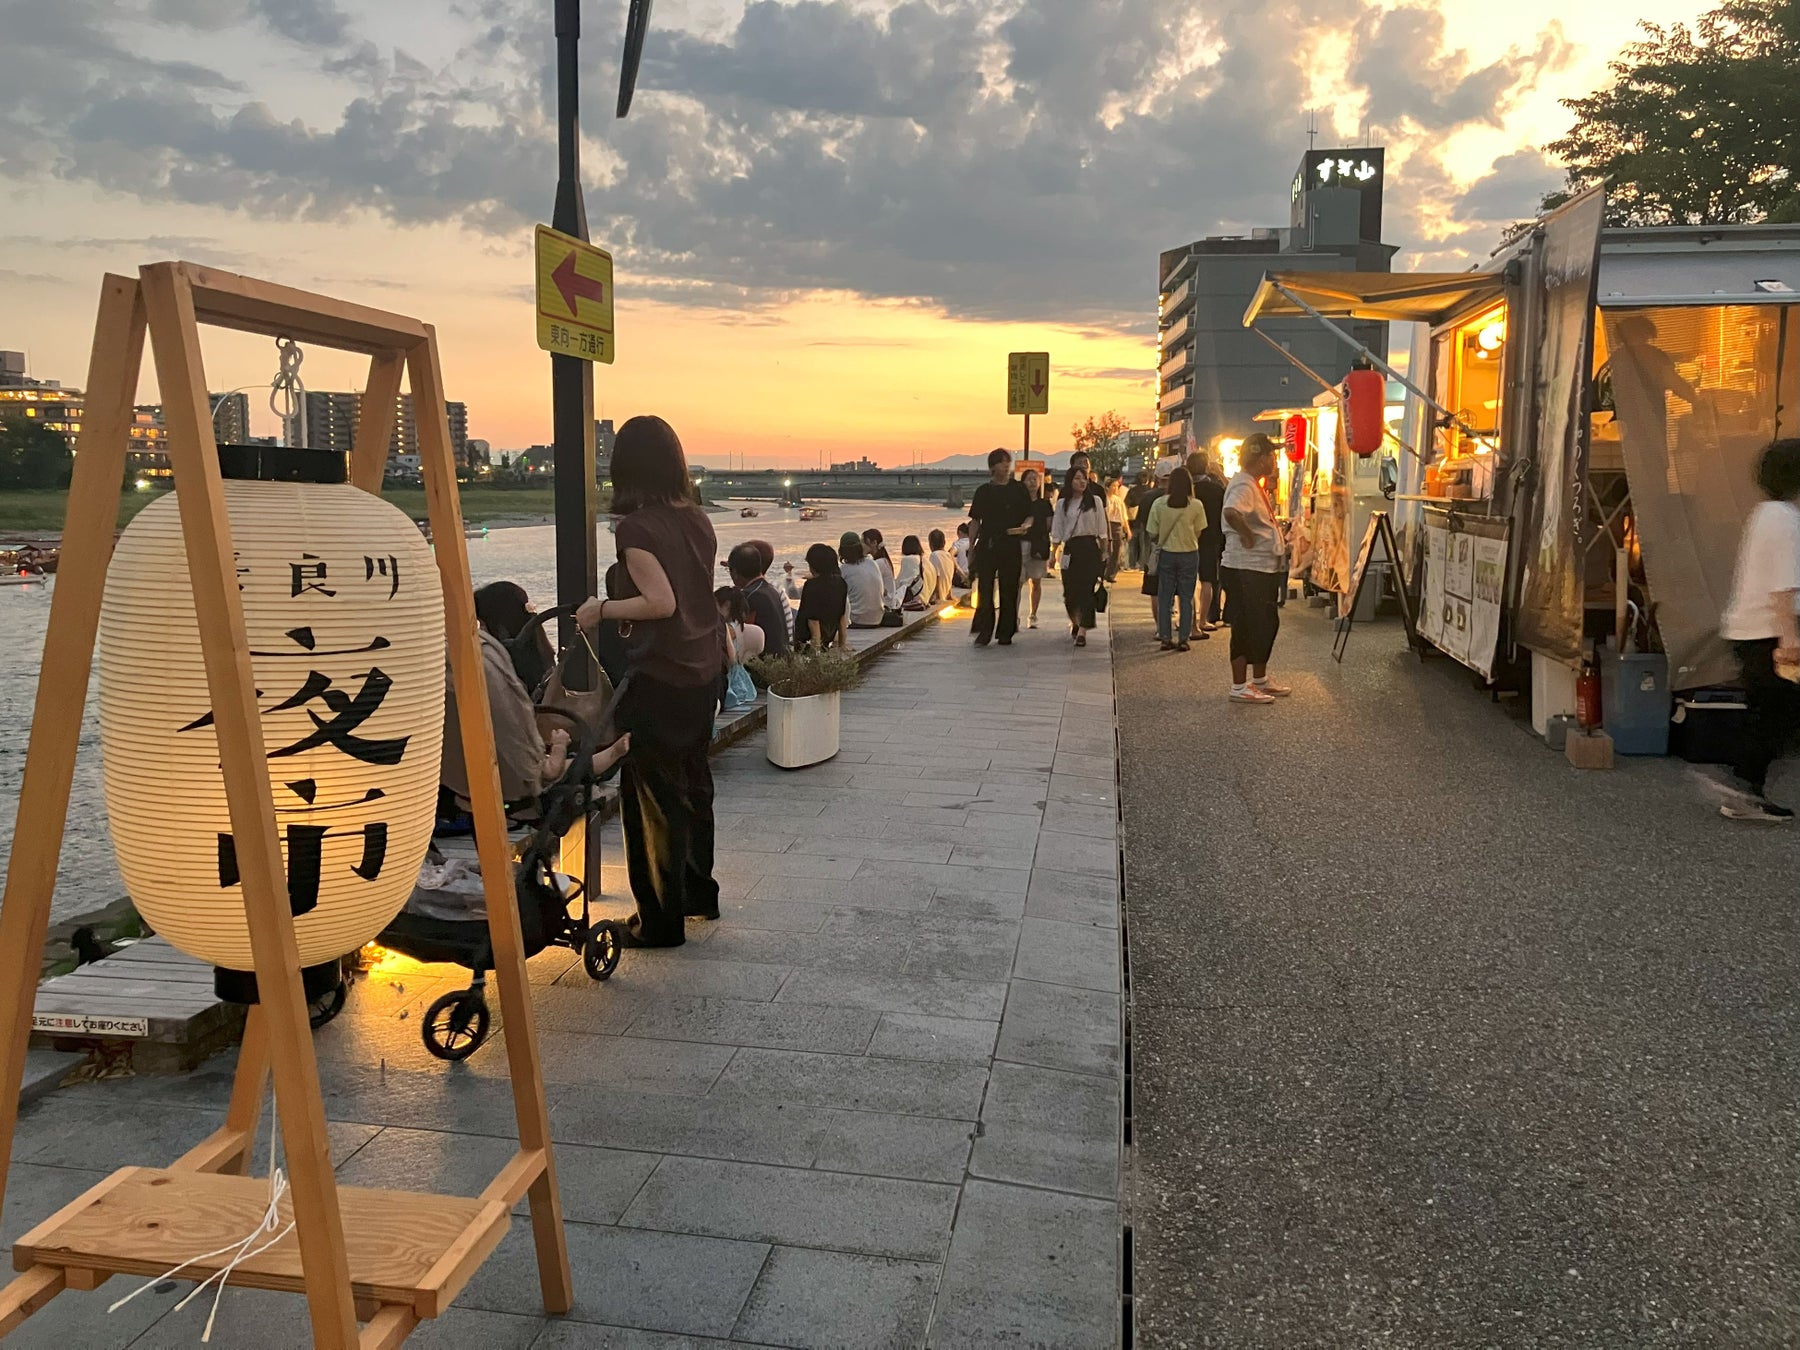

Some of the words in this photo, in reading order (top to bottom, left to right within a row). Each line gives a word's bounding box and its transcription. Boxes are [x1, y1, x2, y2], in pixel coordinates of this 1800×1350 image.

[550, 324, 605, 356] 東向一方通行
